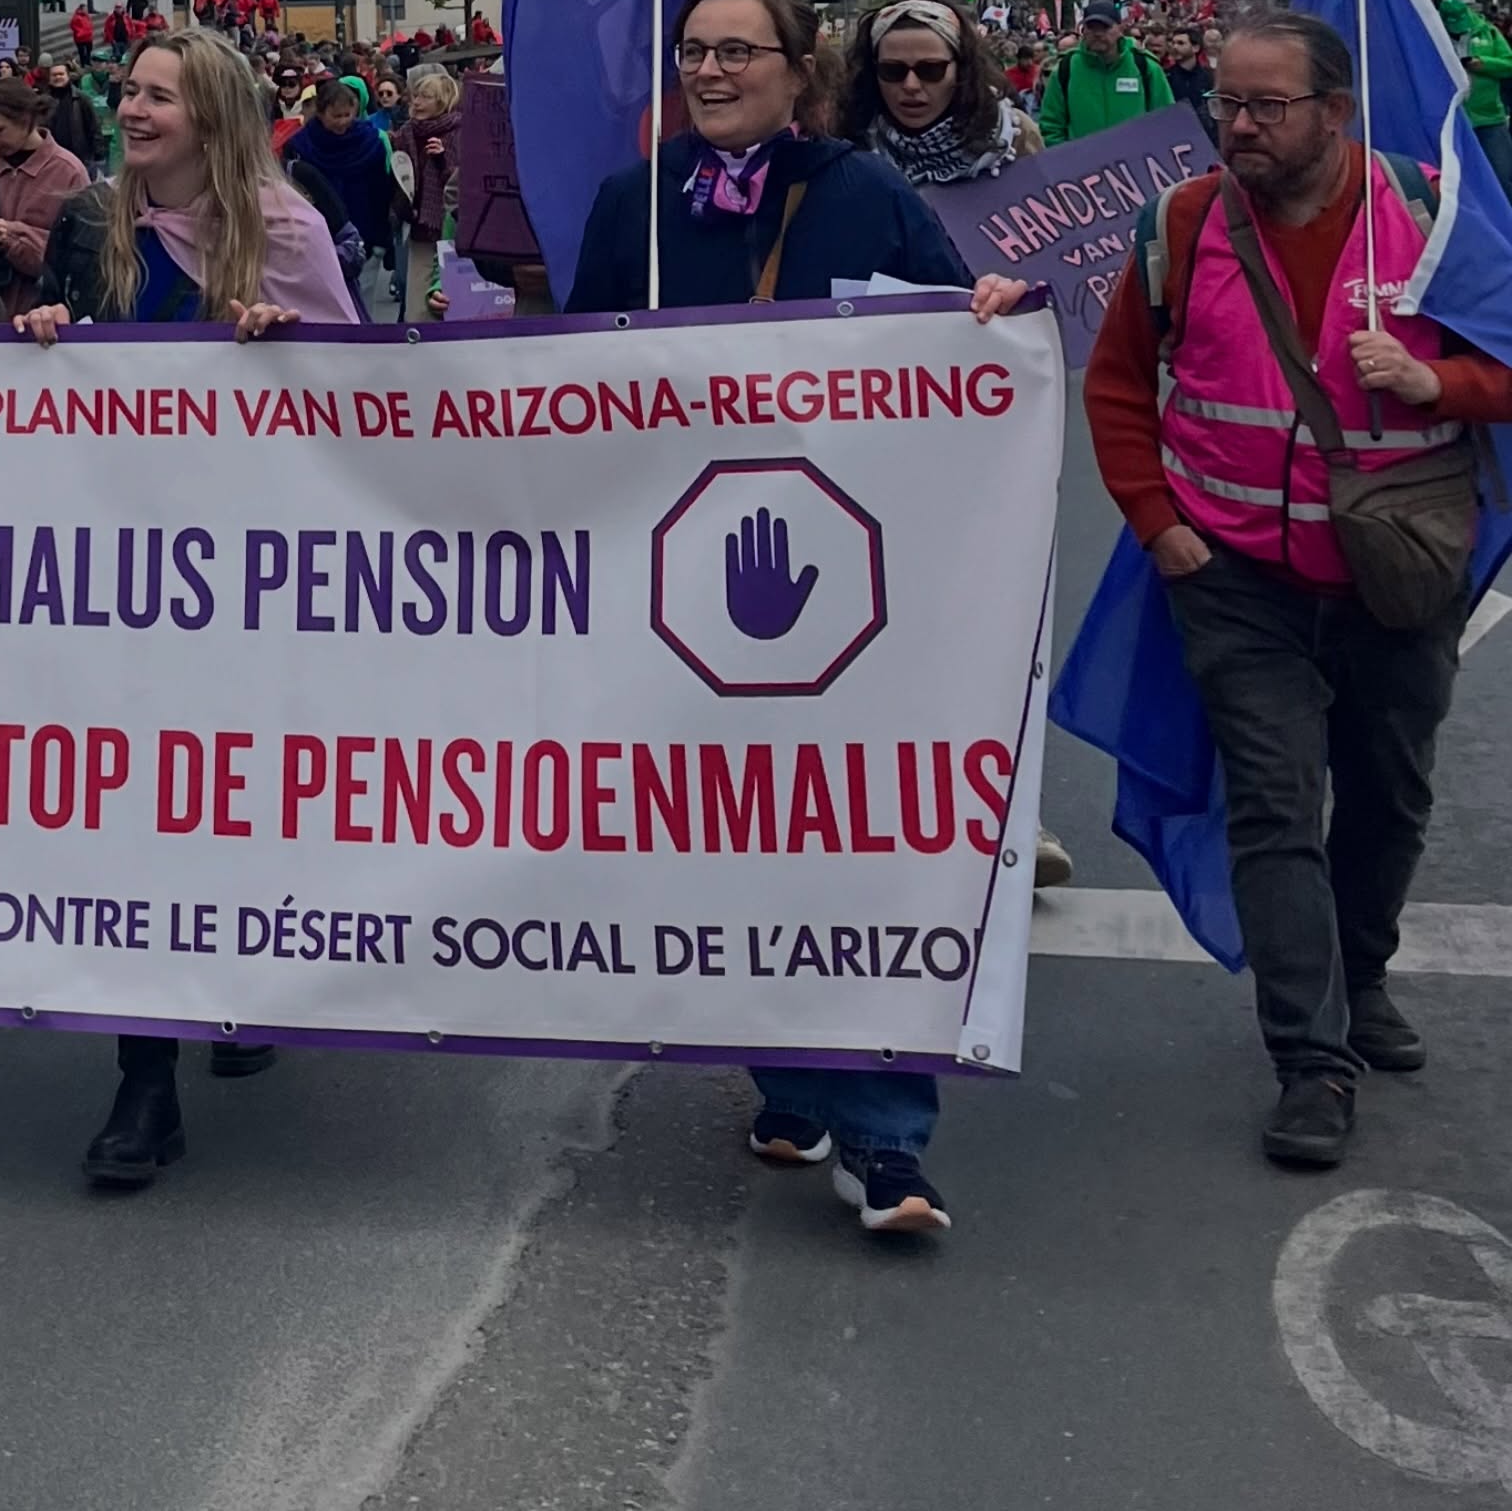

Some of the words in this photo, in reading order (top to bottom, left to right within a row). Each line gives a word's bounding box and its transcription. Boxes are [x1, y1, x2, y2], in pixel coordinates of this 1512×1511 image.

[978, 159, 1147, 264] HANDEN
[1063, 232, 1126, 267] VAN
[233, 388, 342, 439] VAN
[353, 392, 414, 438] DE
[432, 363, 1014, 439] ARIZONA-REGERING
[244, 528, 590, 637] PENSION
[157, 730, 253, 837] DE
[282, 734, 1012, 855] PENSIOENMALUS
[170, 903, 217, 953] LE
[237, 894, 412, 965] DÉSERT
[432, 917, 636, 974] SOCIAL
[654, 925, 725, 976] DE
[748, 925, 982, 981] L'ARIZO
